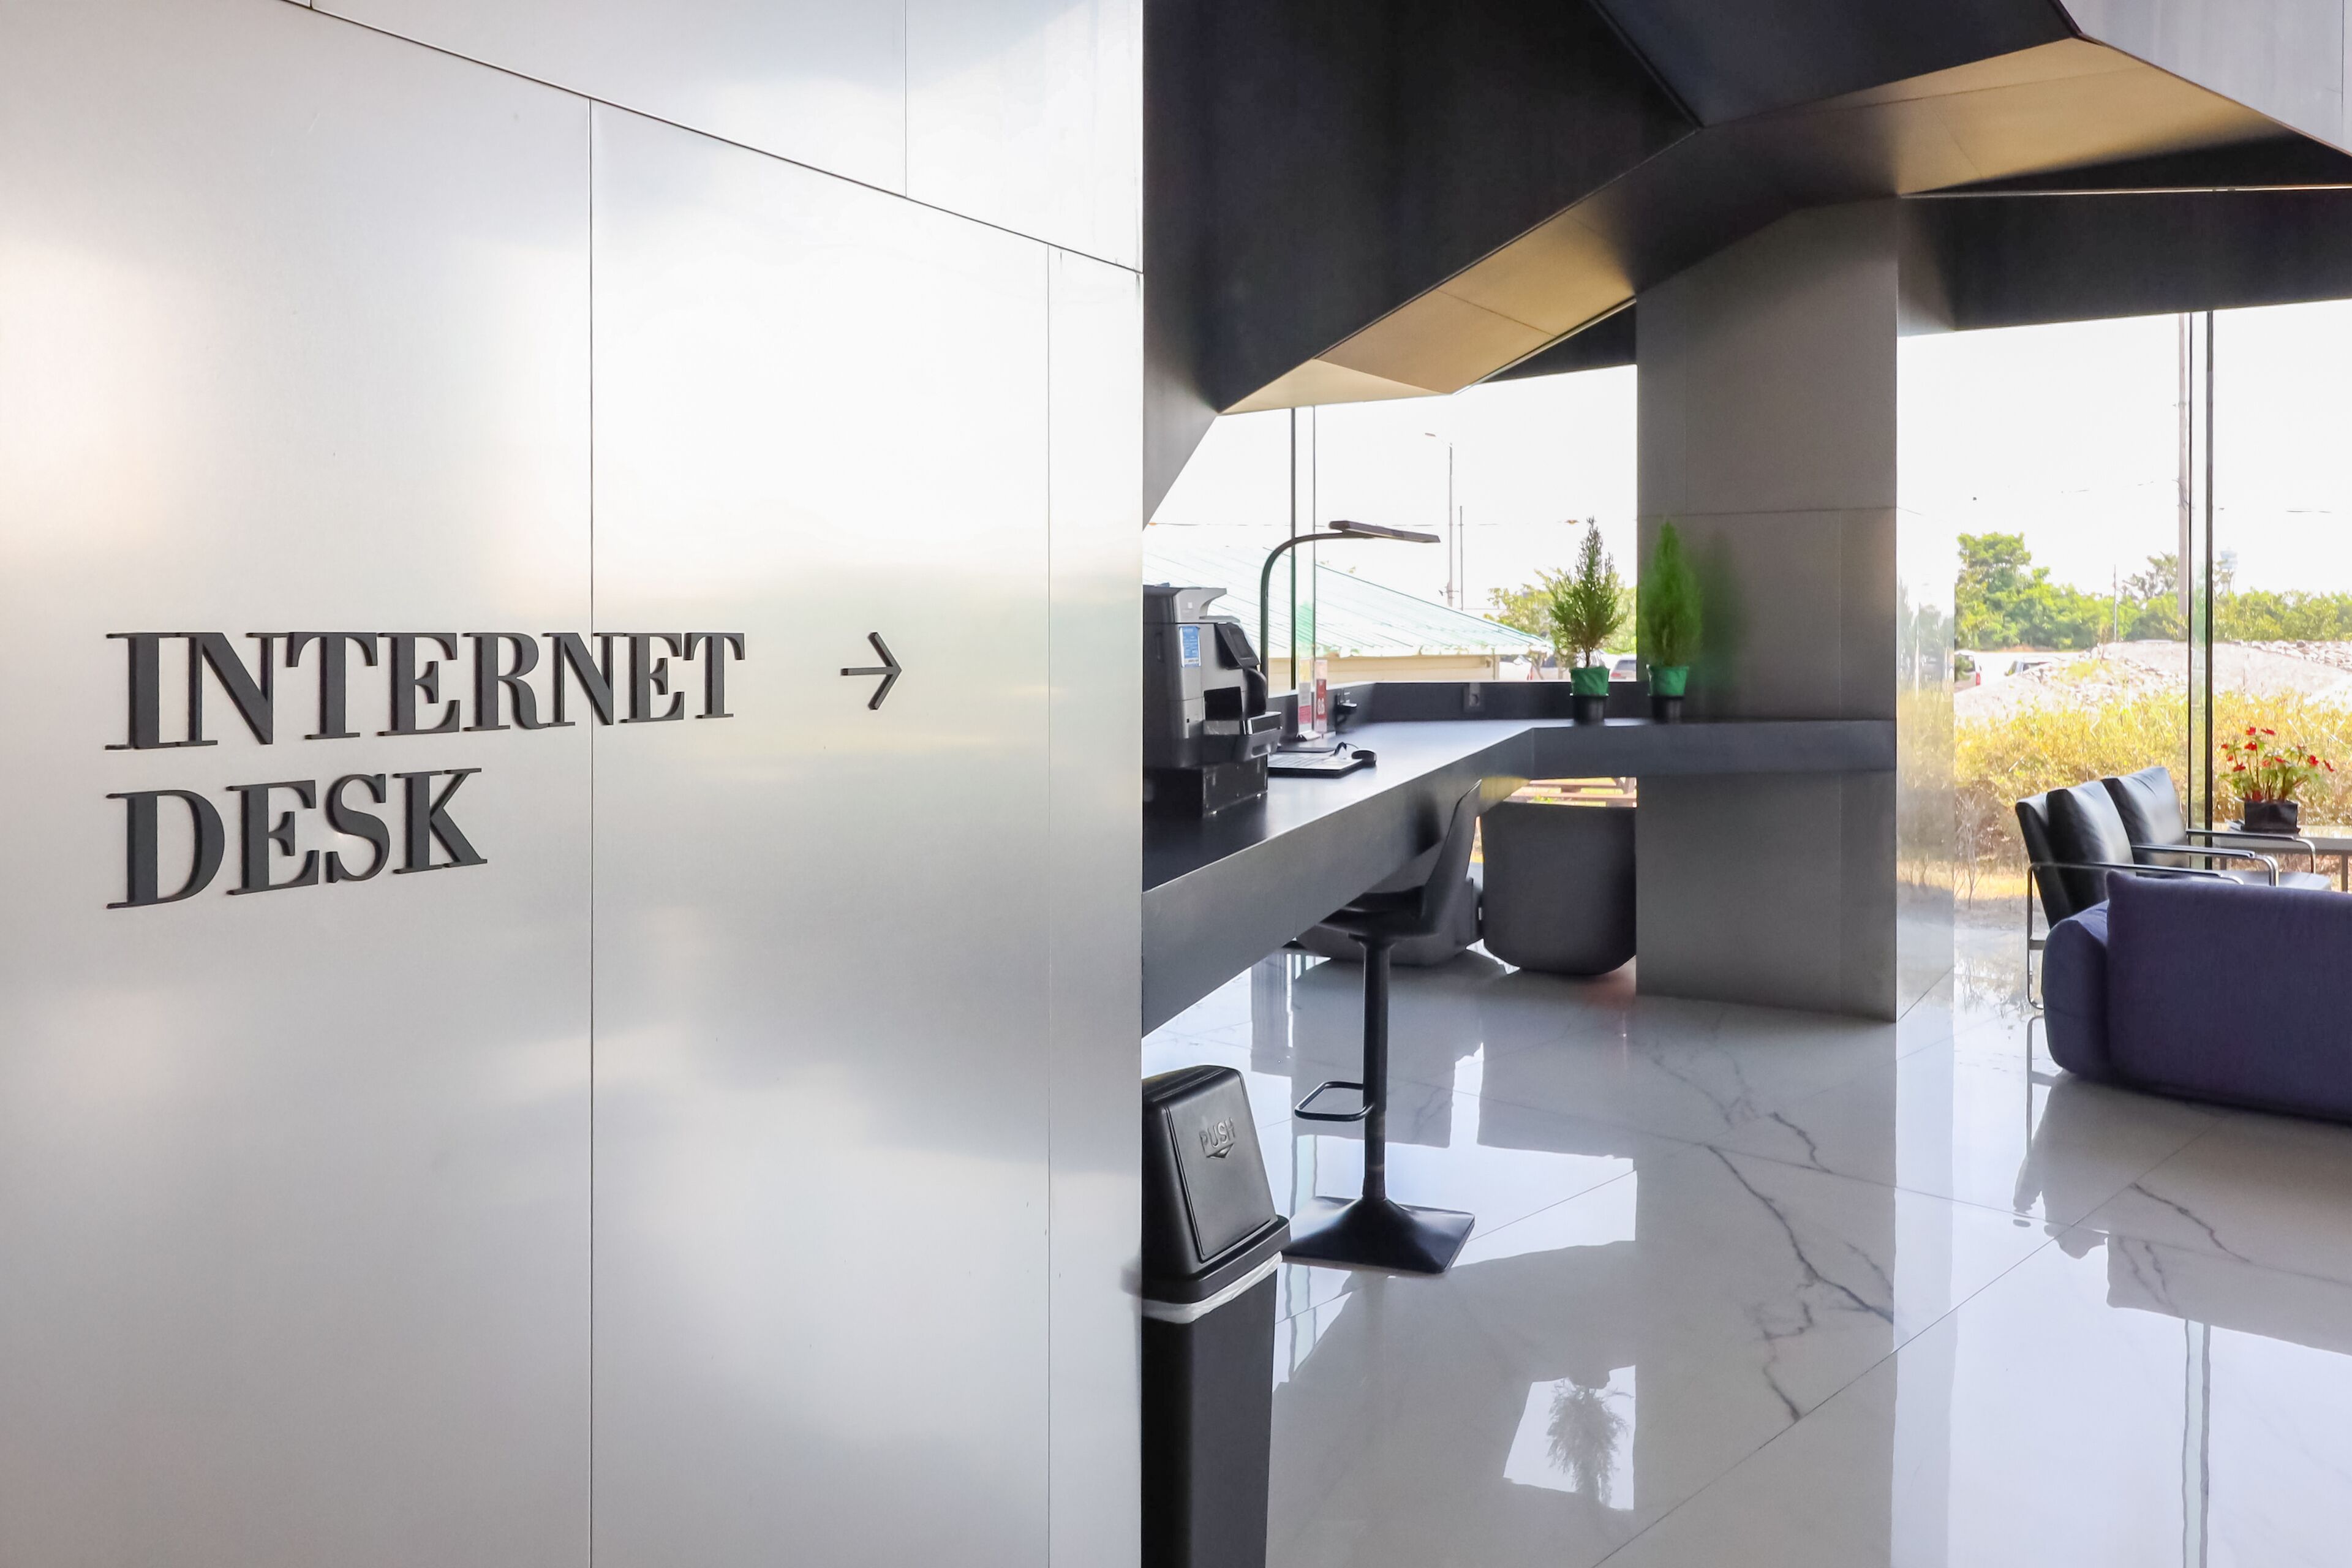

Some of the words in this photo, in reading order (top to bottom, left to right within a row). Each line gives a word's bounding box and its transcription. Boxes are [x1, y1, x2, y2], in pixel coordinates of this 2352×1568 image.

[104, 631, 745, 750] INTERNET
[105, 767, 488, 910] DESK
[1199, 1117, 1235, 1154] PUSH
